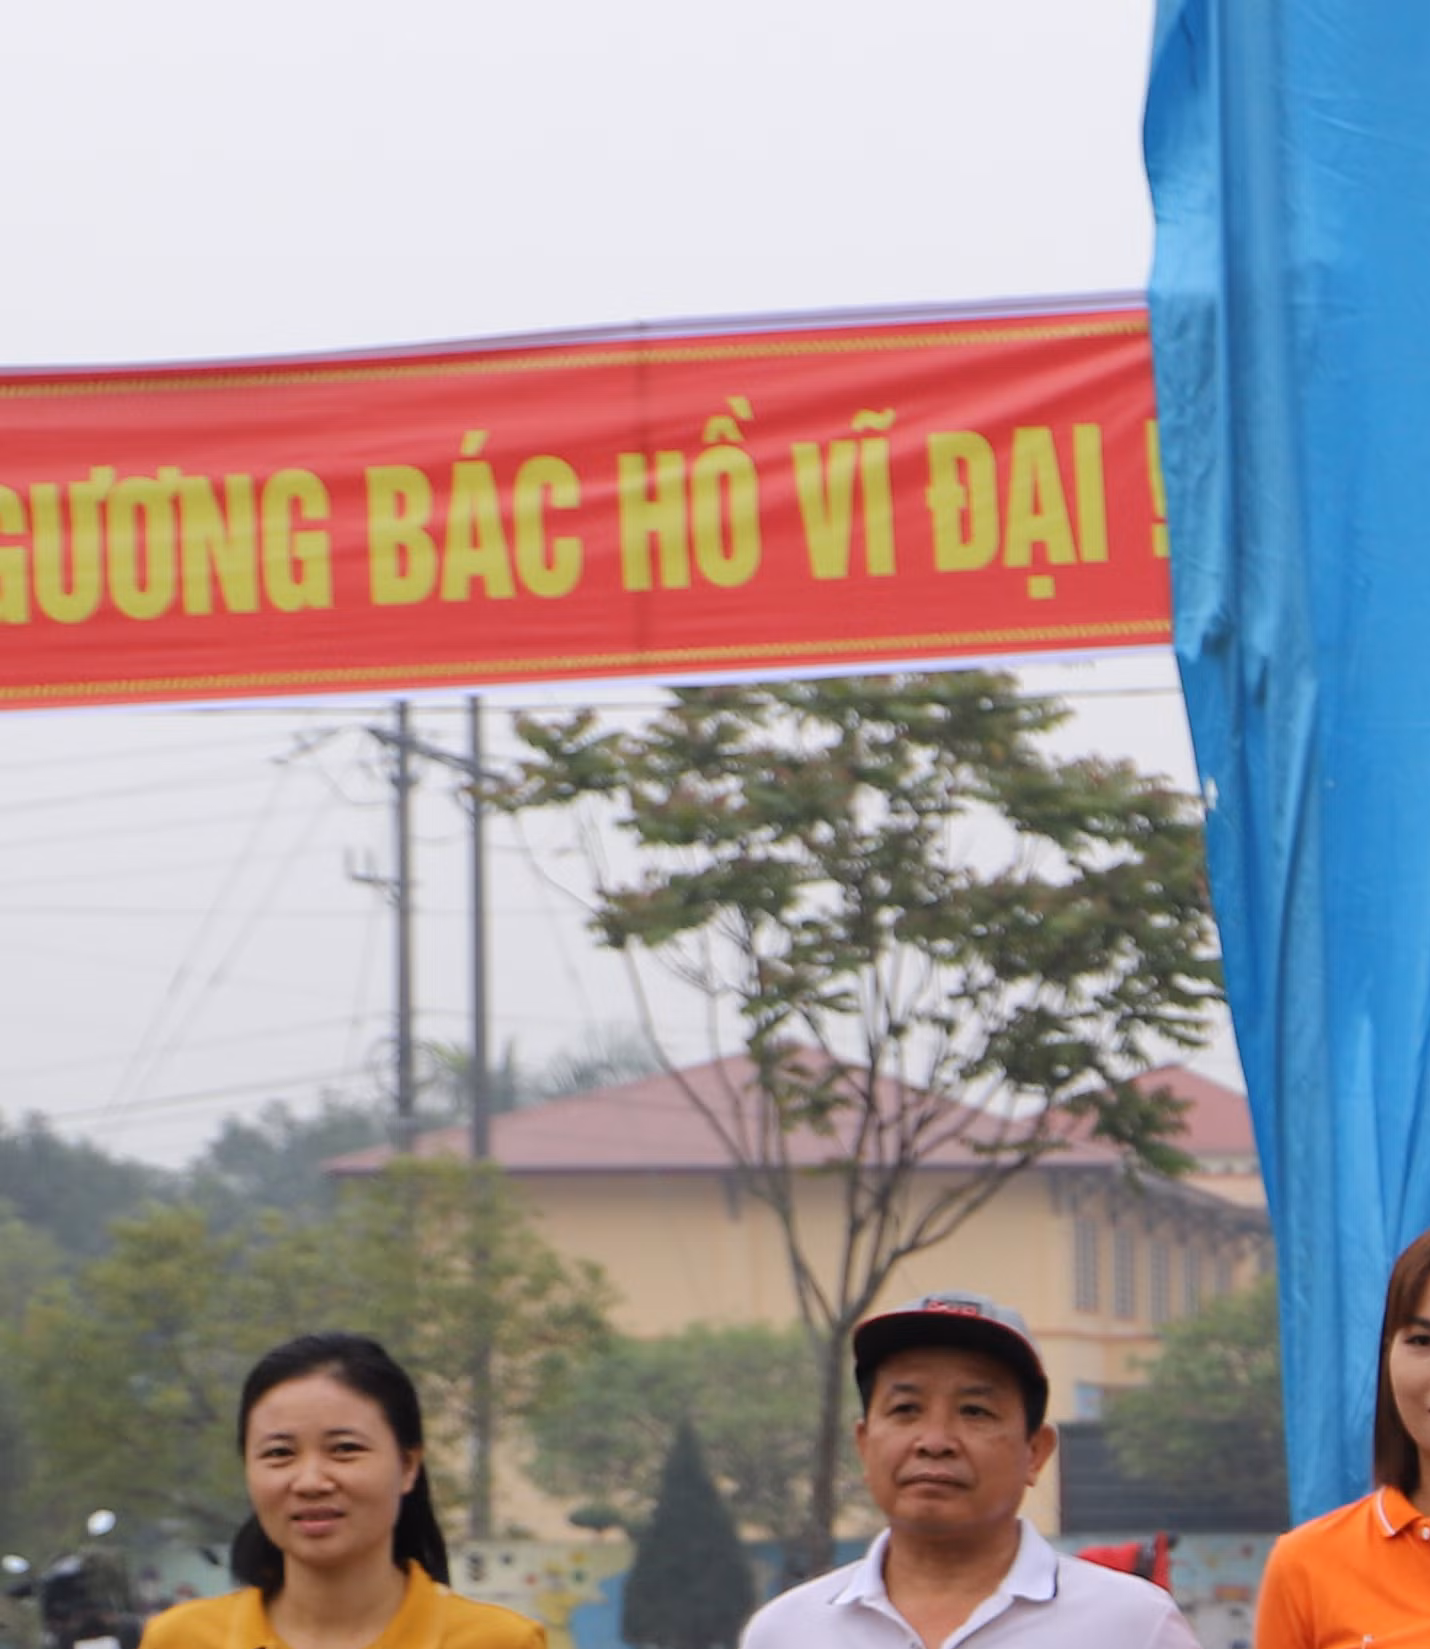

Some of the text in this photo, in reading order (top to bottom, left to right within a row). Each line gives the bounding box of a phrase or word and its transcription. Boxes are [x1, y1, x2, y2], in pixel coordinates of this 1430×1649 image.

[366, 428, 583, 606] BÁC
[619, 396, 760, 589] HỒ
[792, 407, 895, 580] VĨ
[926, 422, 1108, 600] ĐẠI
